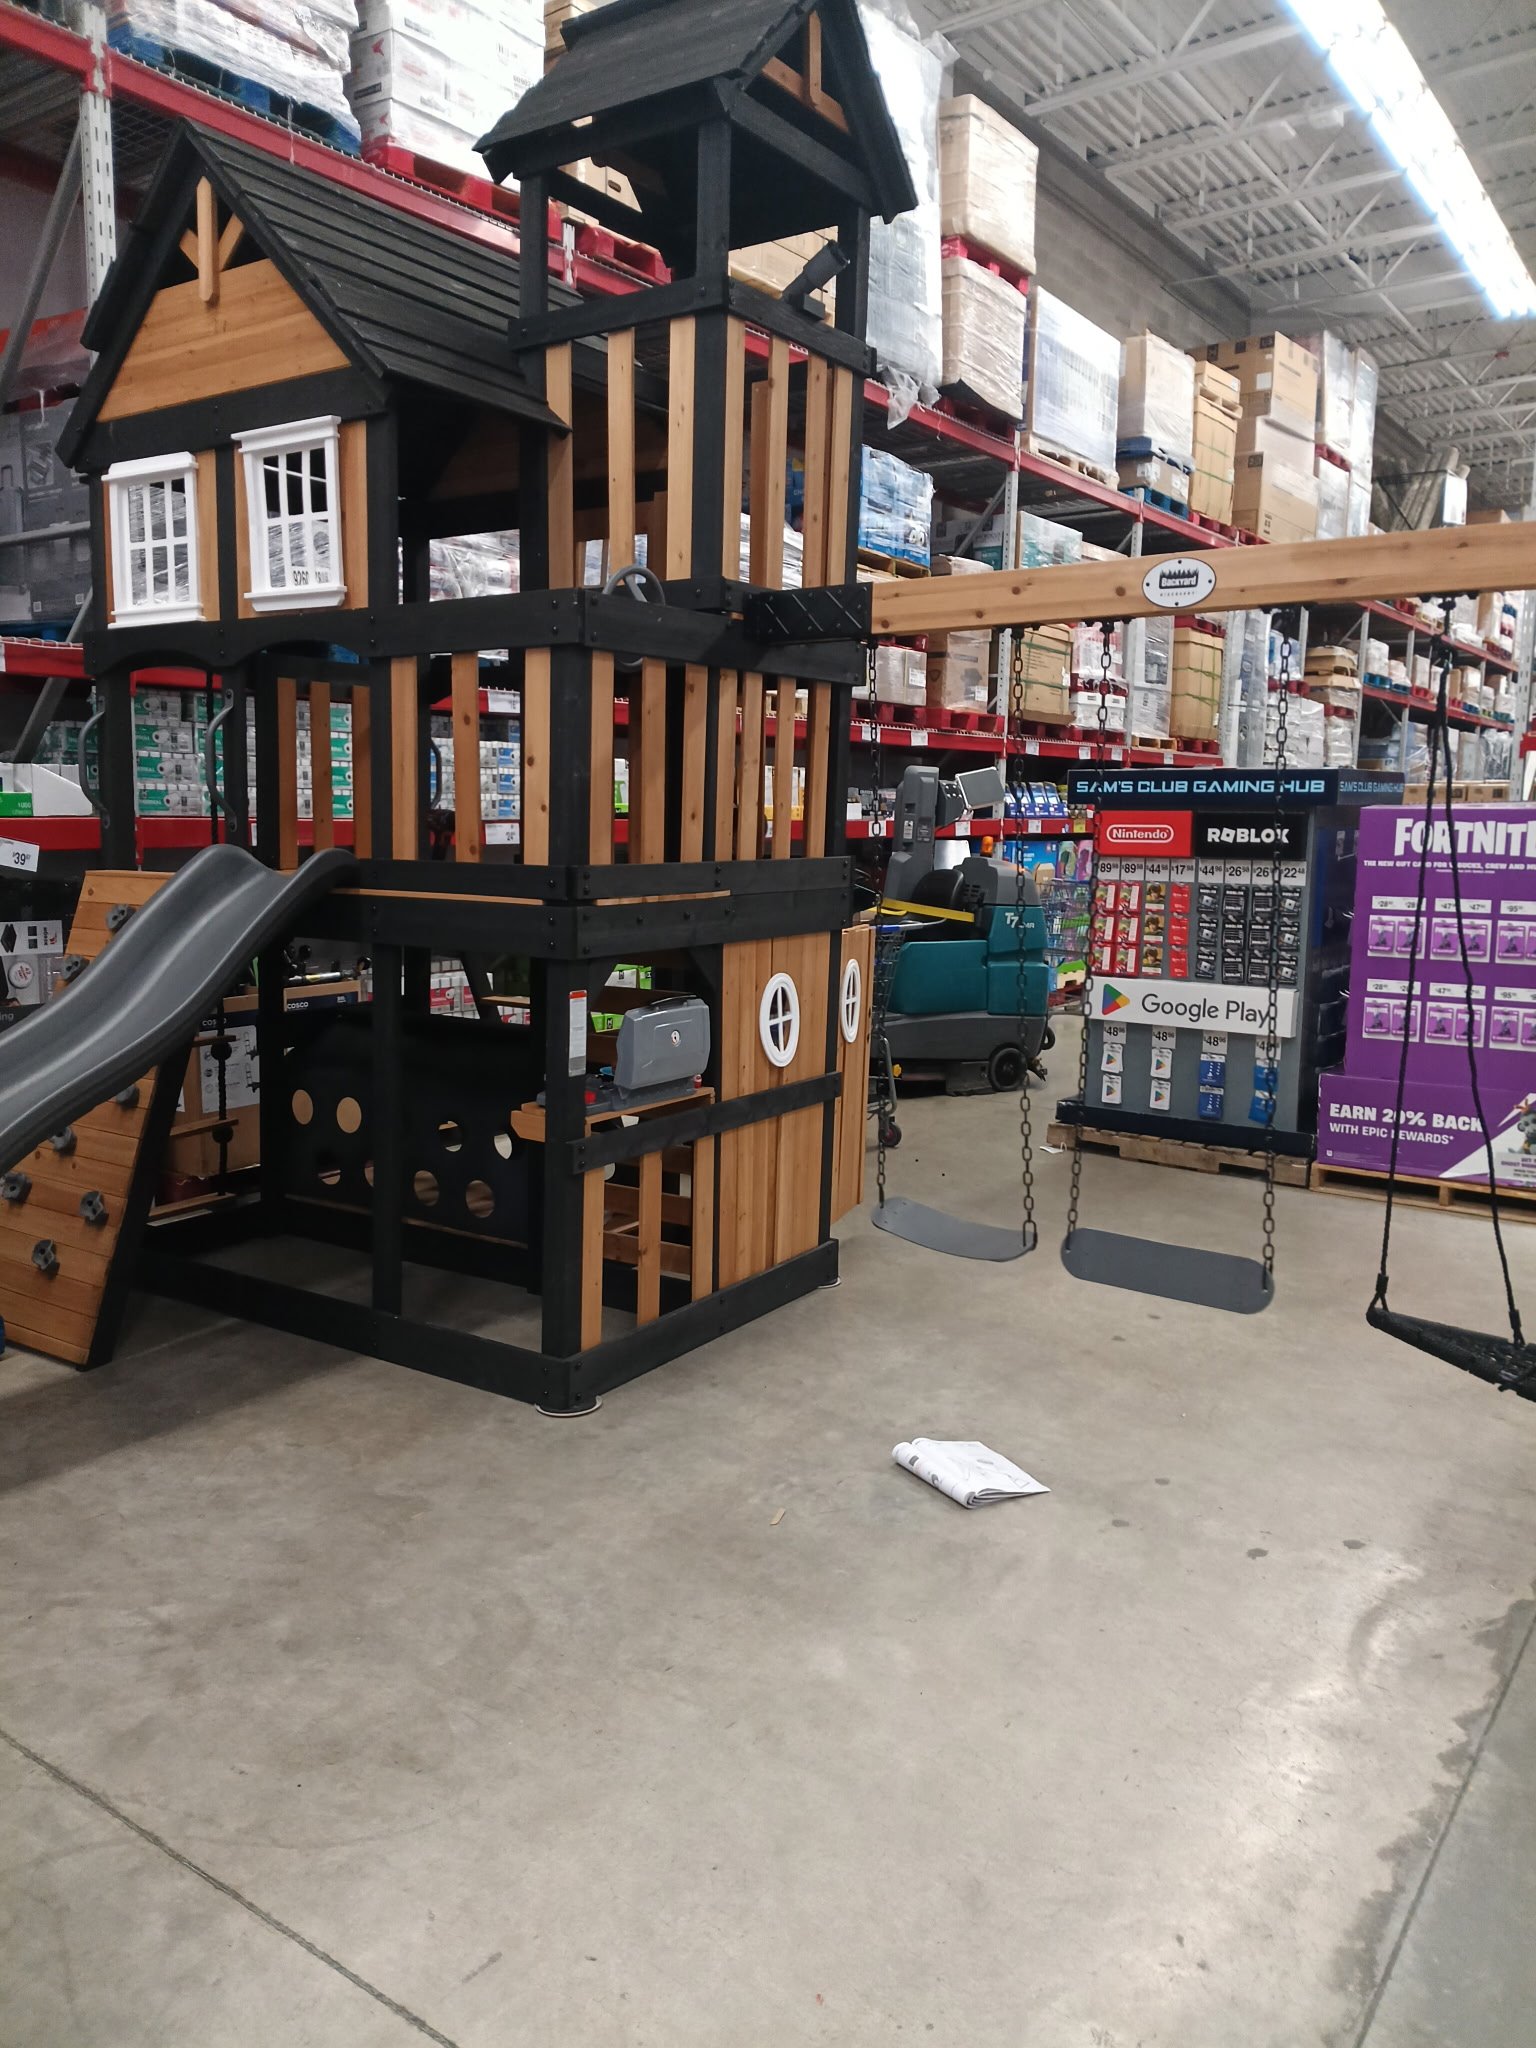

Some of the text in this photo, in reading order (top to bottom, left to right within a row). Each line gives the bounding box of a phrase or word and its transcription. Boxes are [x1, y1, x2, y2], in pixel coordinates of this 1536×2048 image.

[1076, 780, 1325, 793] SAM'S CLUB GAMING HUB
[1112, 828, 1168, 839] Nintendo
[1207, 827, 1290, 844] ROBLOX
[1004, 911, 1019, 928] T7
[287, 1001, 309, 1010] COSCO
[1141, 993, 1270, 1028] Google Play
[202, 1018, 227, 1027] COSO
[1329, 1103, 1484, 1133] EARN 20% BACK
[1329, 1122, 1359, 1136] WITH
[1362, 1126, 1388, 1138] EPIC
